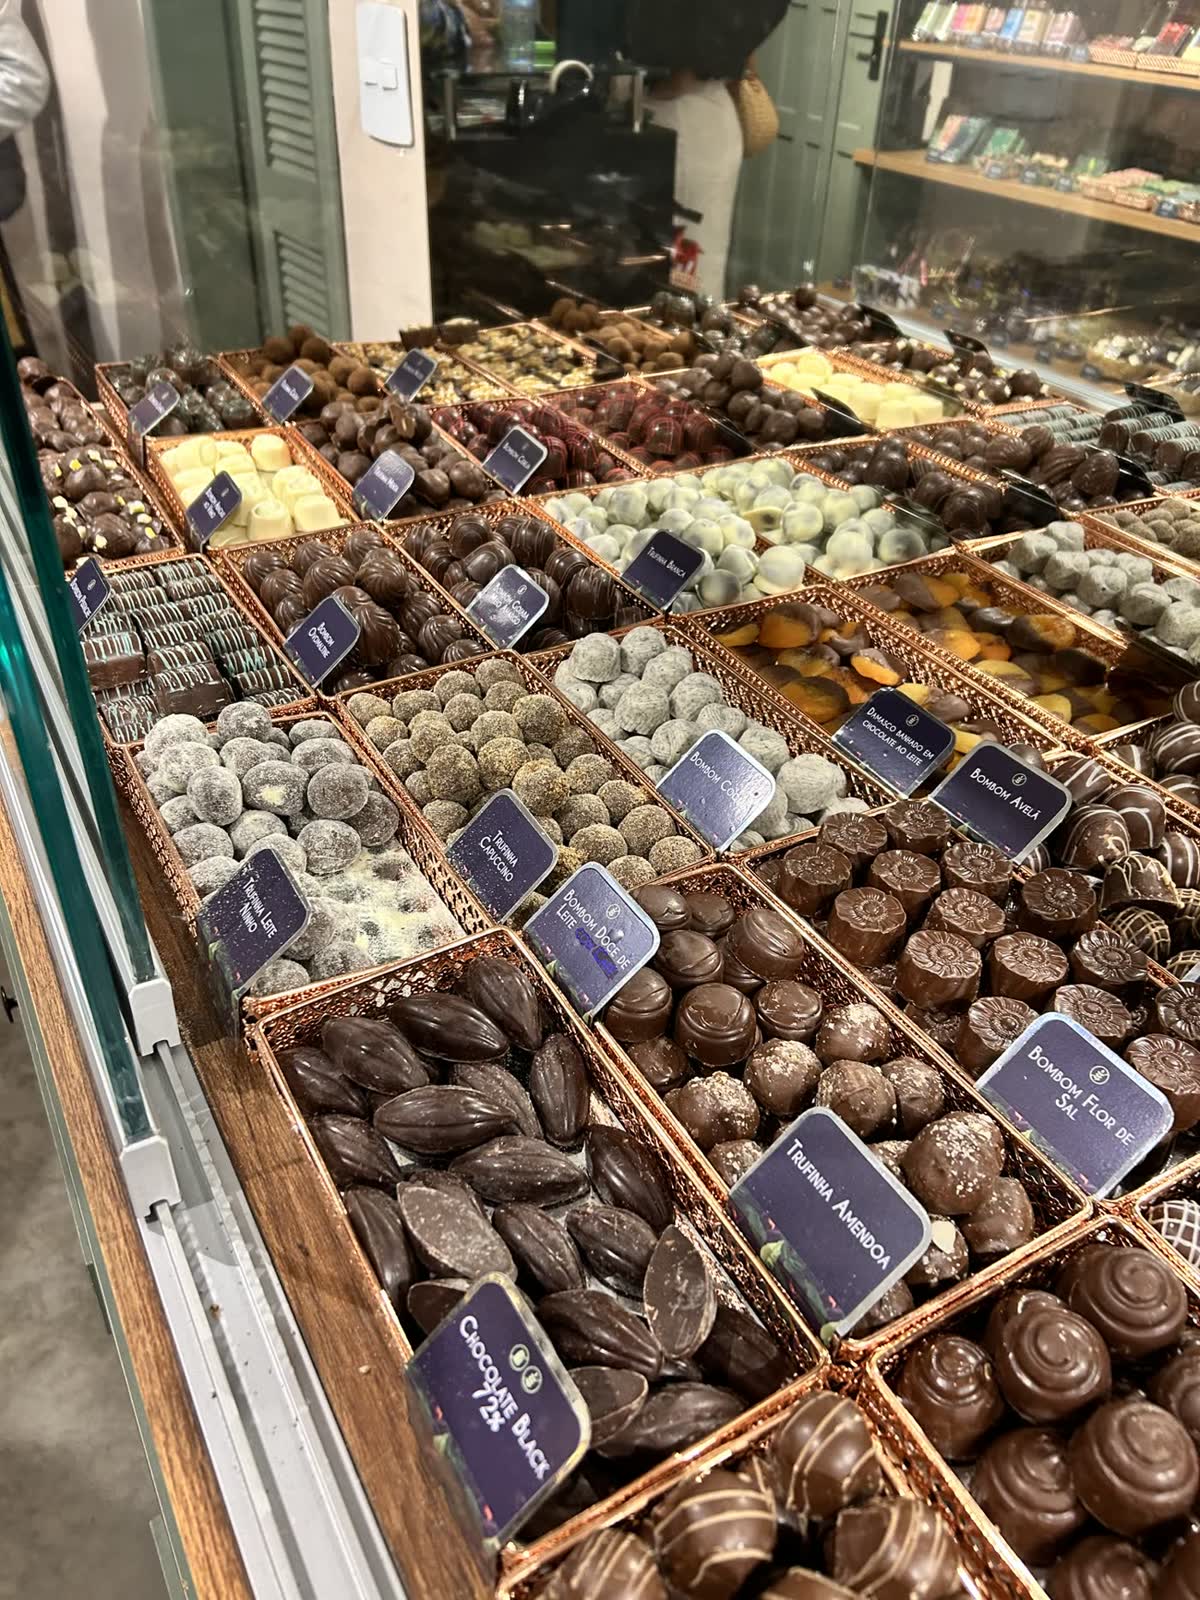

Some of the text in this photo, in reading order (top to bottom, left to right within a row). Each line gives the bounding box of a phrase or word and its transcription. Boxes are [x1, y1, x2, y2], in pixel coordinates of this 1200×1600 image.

[862, 719, 923, 767] CHOCOLATE AO LEITE
[866, 706, 935, 761] DAMASCO BANHADO EM
[690, 751, 743, 804] BOMBOM COC
[970, 767, 1041, 821] BOMBOM AVELÃ
[480, 836, 514, 882] CAPUCCINO
[492, 829, 519, 868] TRUFINHA
[239, 902, 258, 933] NINHO
[243, 876, 278, 939] TRUFINHA LEITE
[556, 903, 578, 930] LEITE
[563, 888, 598, 931] BOMBOM
[594, 925, 621, 957] DOCE
[616, 954, 632, 971] DE
[1028, 1045, 1136, 1146] BOMBOM FLOR DE
[1055, 1093, 1080, 1121] SAL
[786, 1138, 892, 1270] TRUFINHA AMENDOA
[459, 1315, 550, 1480] CHOCOLATE BLACK
[472, 1379, 506, 1433] 72%
